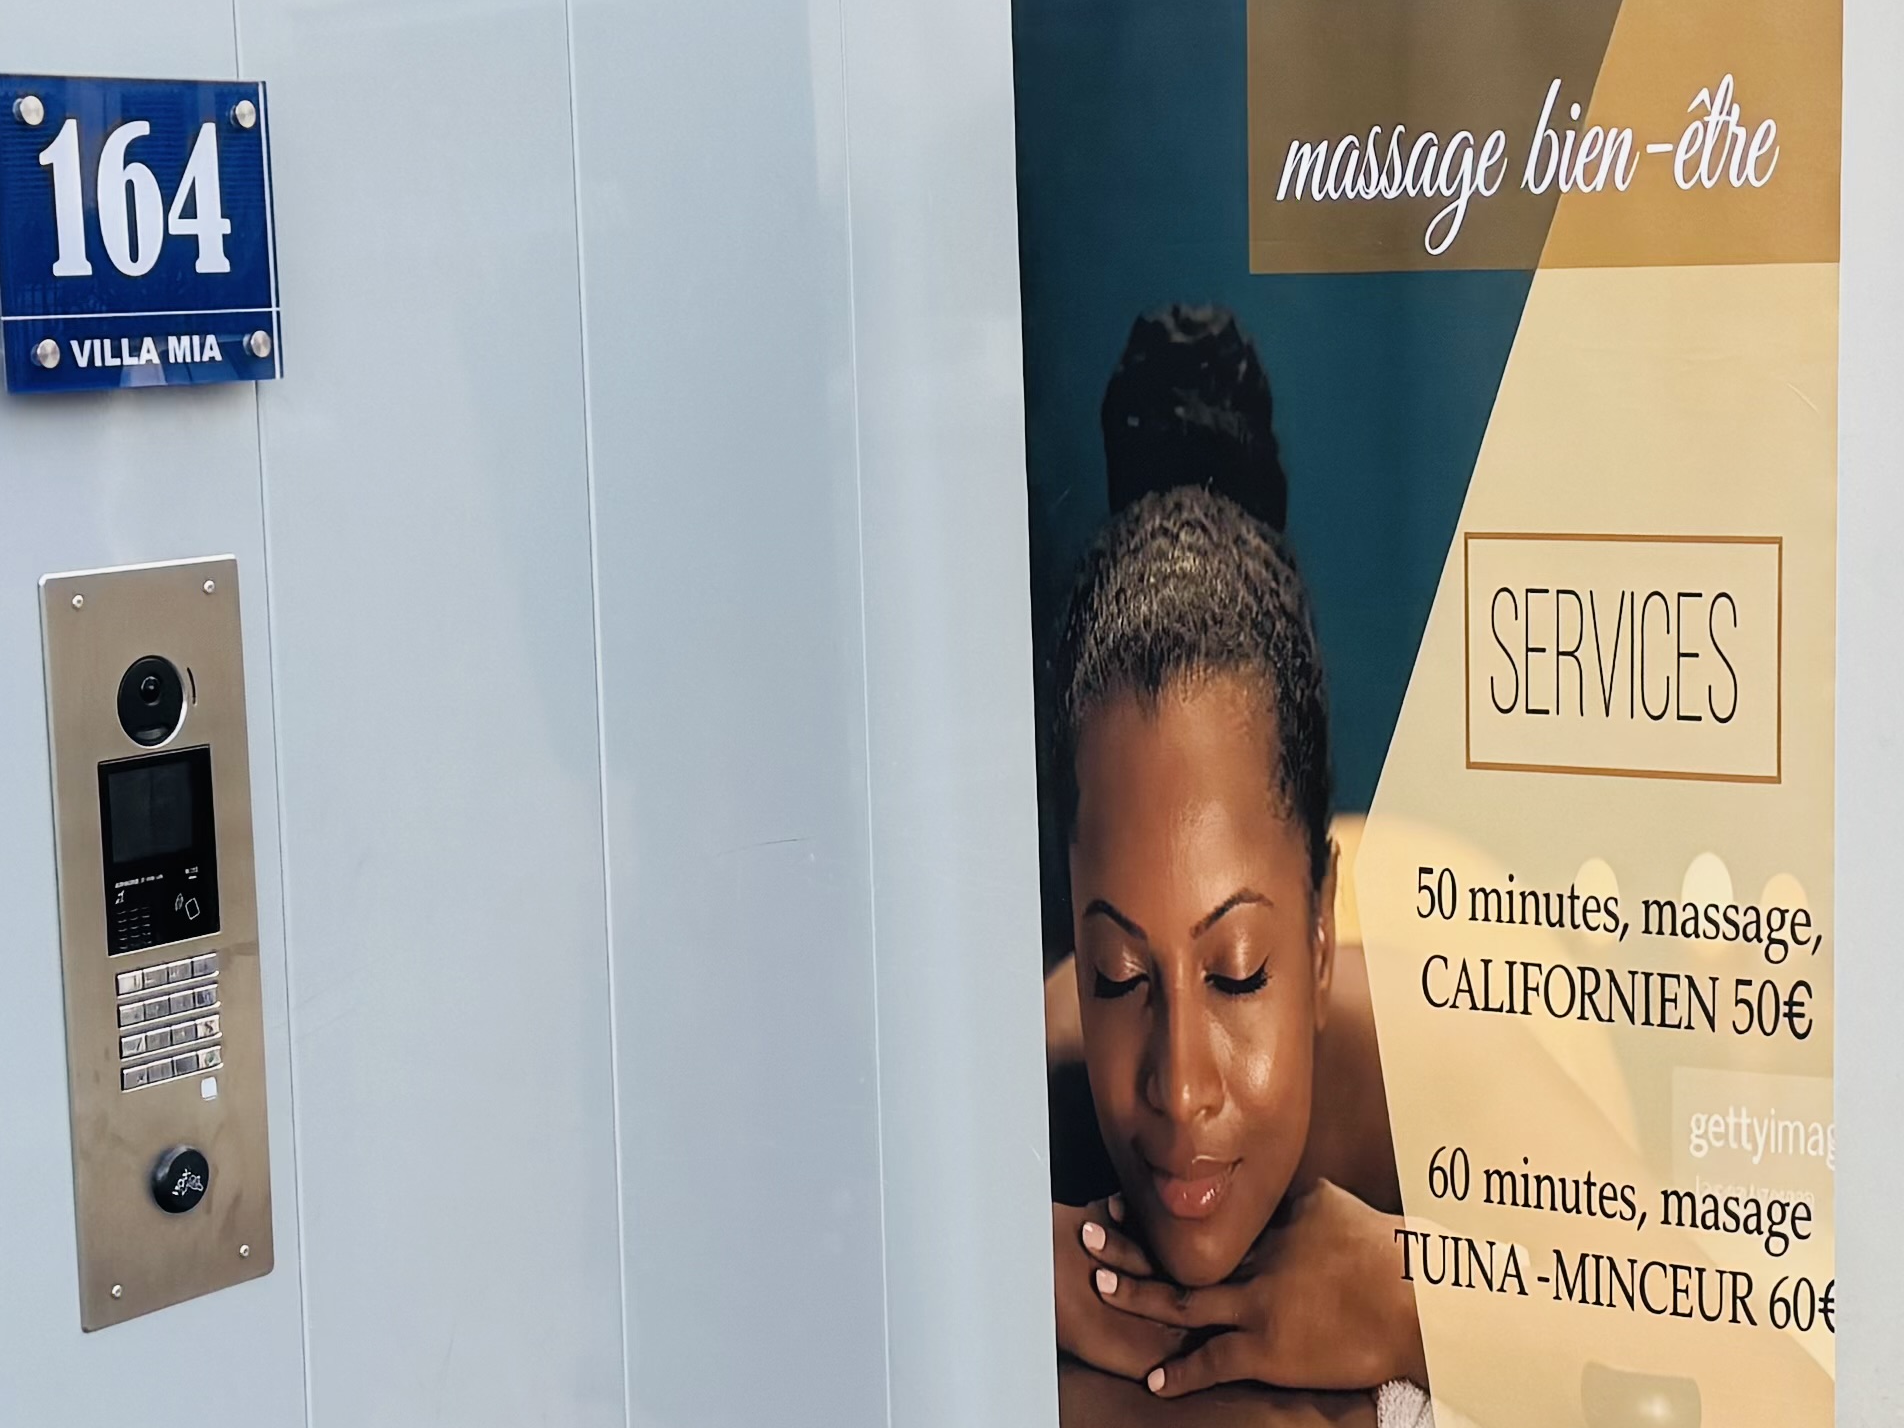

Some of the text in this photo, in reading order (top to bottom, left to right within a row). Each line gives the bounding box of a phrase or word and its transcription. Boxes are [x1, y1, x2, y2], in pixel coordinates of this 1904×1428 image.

[38, 118, 232, 277] 164
[1276, 124, 1508, 256] massage
[69, 334, 223, 368] VILLA MIA
[1490, 586, 1738, 724] SERVICES
[1416, 866, 1824, 965] 50 minutes, massage,
[1421, 954, 1814, 1041] CALIFORNIEN 50€
[1427, 1145, 1470, 1201] 60
[1483, 1156, 1649, 1232] minutes,
[1659, 1186, 1813, 1257] masage
[1394, 1228, 1529, 1297] TUINA
